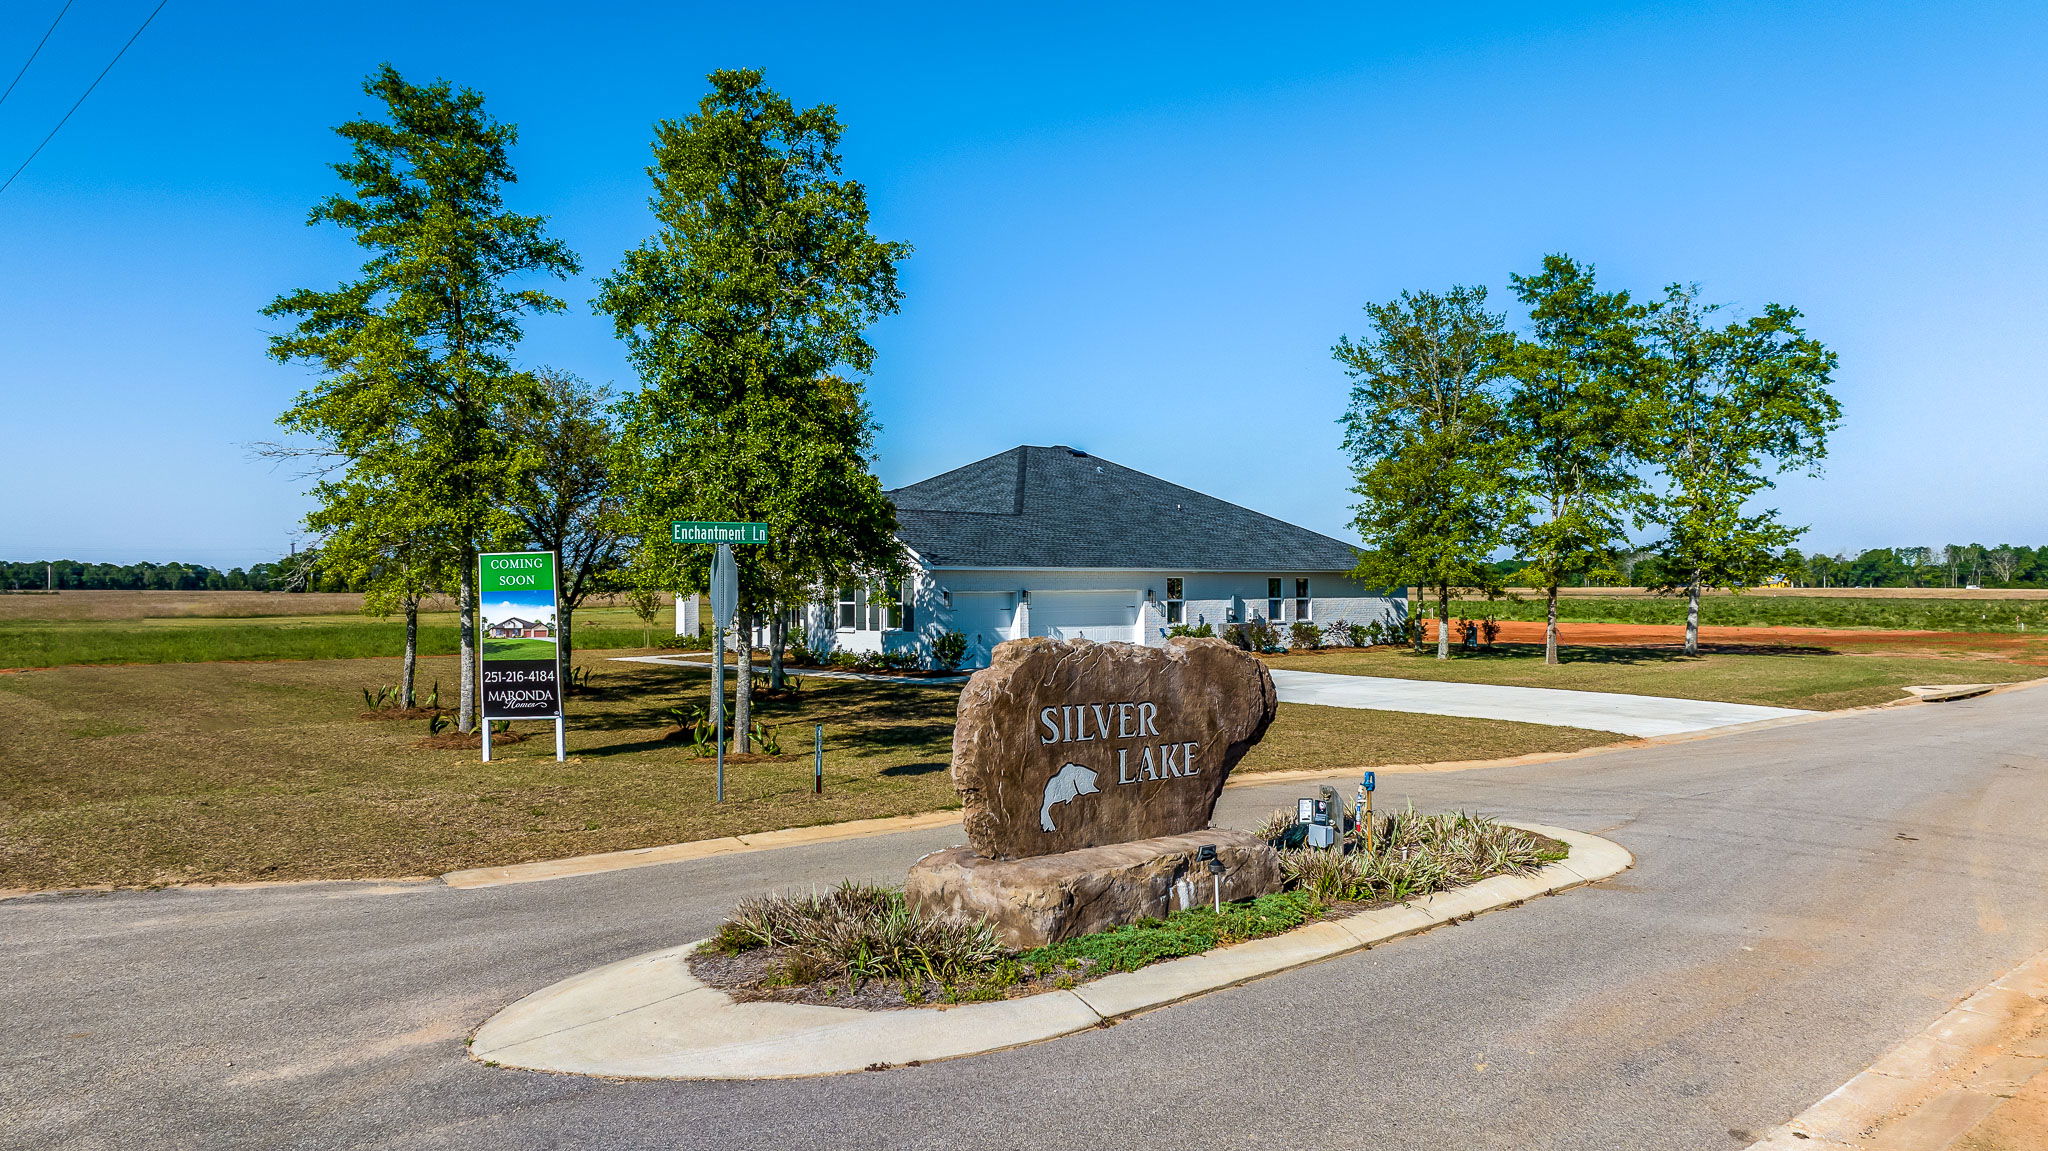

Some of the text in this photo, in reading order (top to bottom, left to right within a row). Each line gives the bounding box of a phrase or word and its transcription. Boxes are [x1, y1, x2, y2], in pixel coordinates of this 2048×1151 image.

[674, 524, 766, 541] Enchantment Ln
[490, 558, 543, 569] COMING
[499, 575, 535, 586] SOON
[484, 670, 555, 683] 251-216-4184
[487, 690, 554, 702] MARONDA
[503, 699, 547, 709] Homes
[1040, 702, 1160, 745] SILVER
[1117, 741, 1200, 785] LAKE
